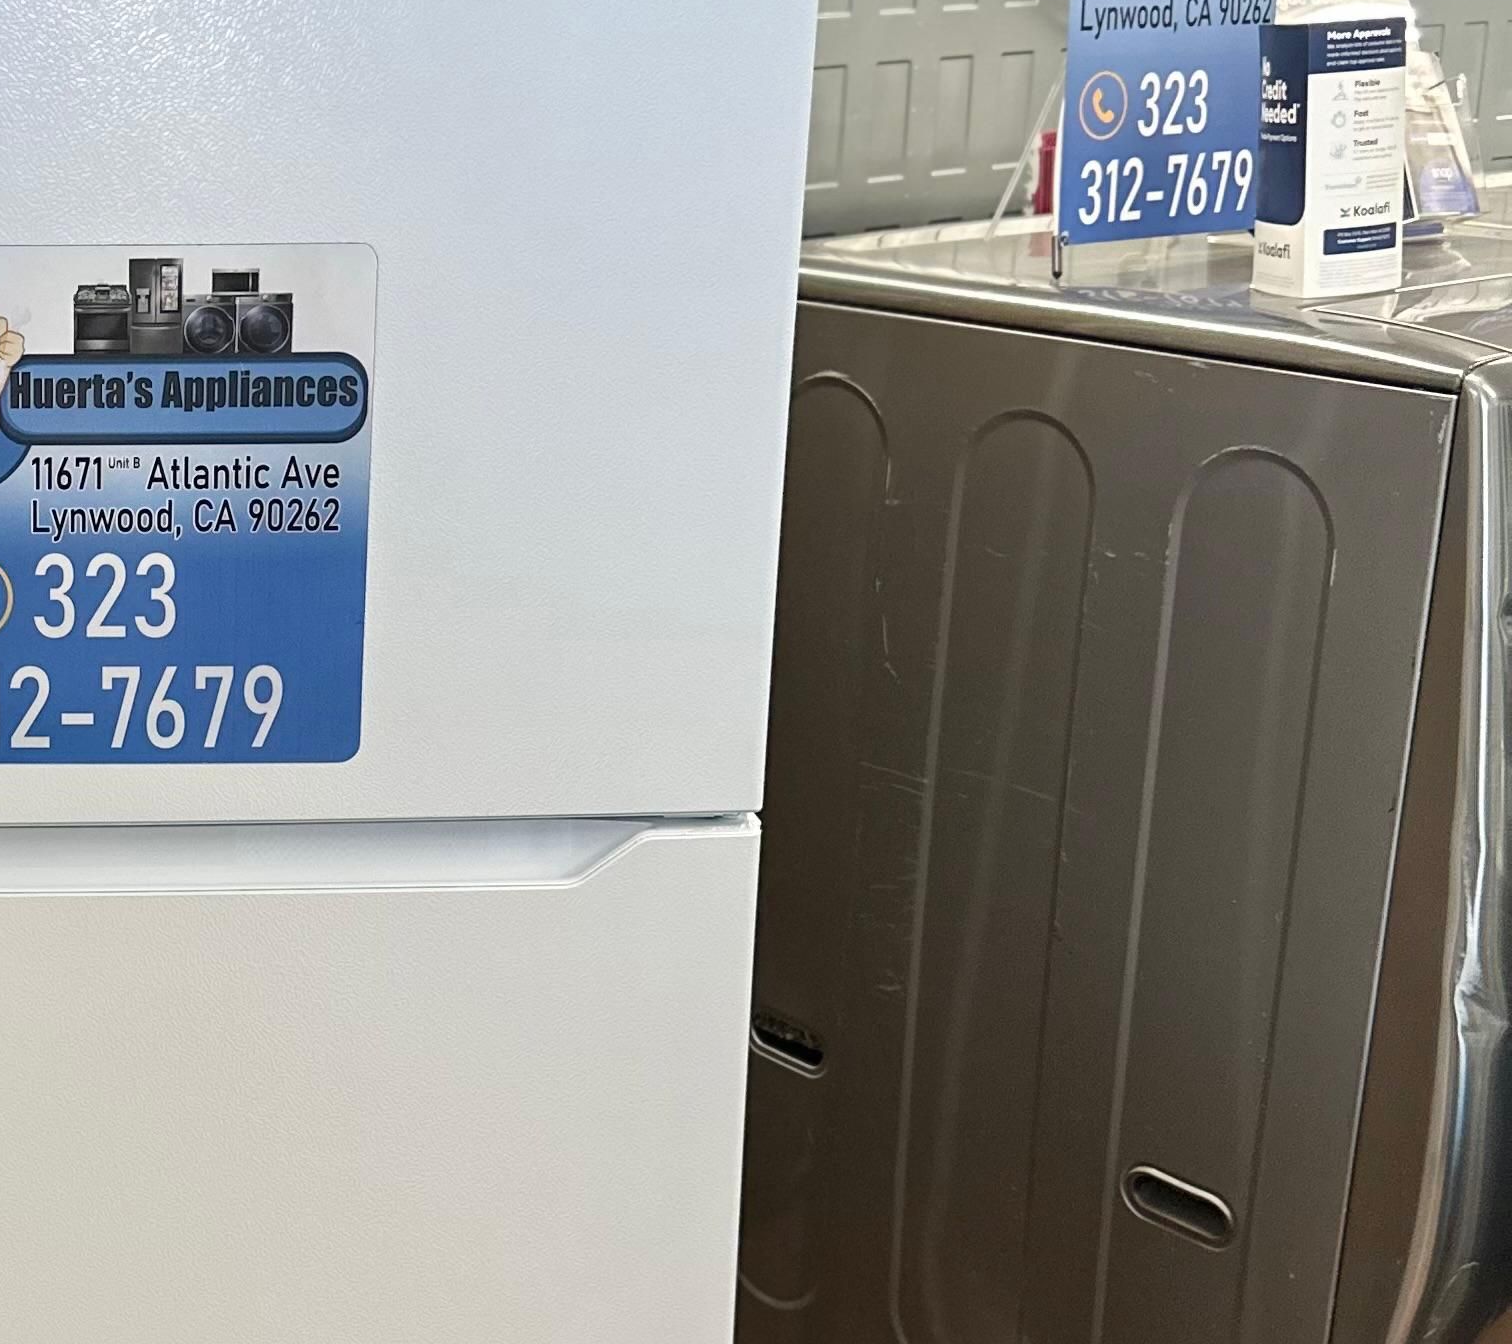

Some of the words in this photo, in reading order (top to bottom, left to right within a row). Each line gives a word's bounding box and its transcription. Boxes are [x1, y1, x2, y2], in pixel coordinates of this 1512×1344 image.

[1327, 30, 1351, 41] More
[1137, 69, 1209, 137] 323
[1354, 110, 1369, 118] Fast
[1353, 139, 1379, 147] Trusted
[1078, 148, 1253, 225] 312-7679
[1353, 201, 1391, 217] Koalafi
[9, 371, 153, 409] Huerta's
[160, 370, 358, 412] Appliances
[31, 457, 103, 491] 11671
[107, 456, 131, 470] Unit
[133, 457, 141, 468] B
[146, 456, 270, 490] Atlantic
[280, 455, 341, 490] Ave
[31, 500, 183, 541] Lynwood,
[193, 500, 237, 533] CA
[248, 497, 341, 532] 90262
[33, 551, 177, 639] 323
